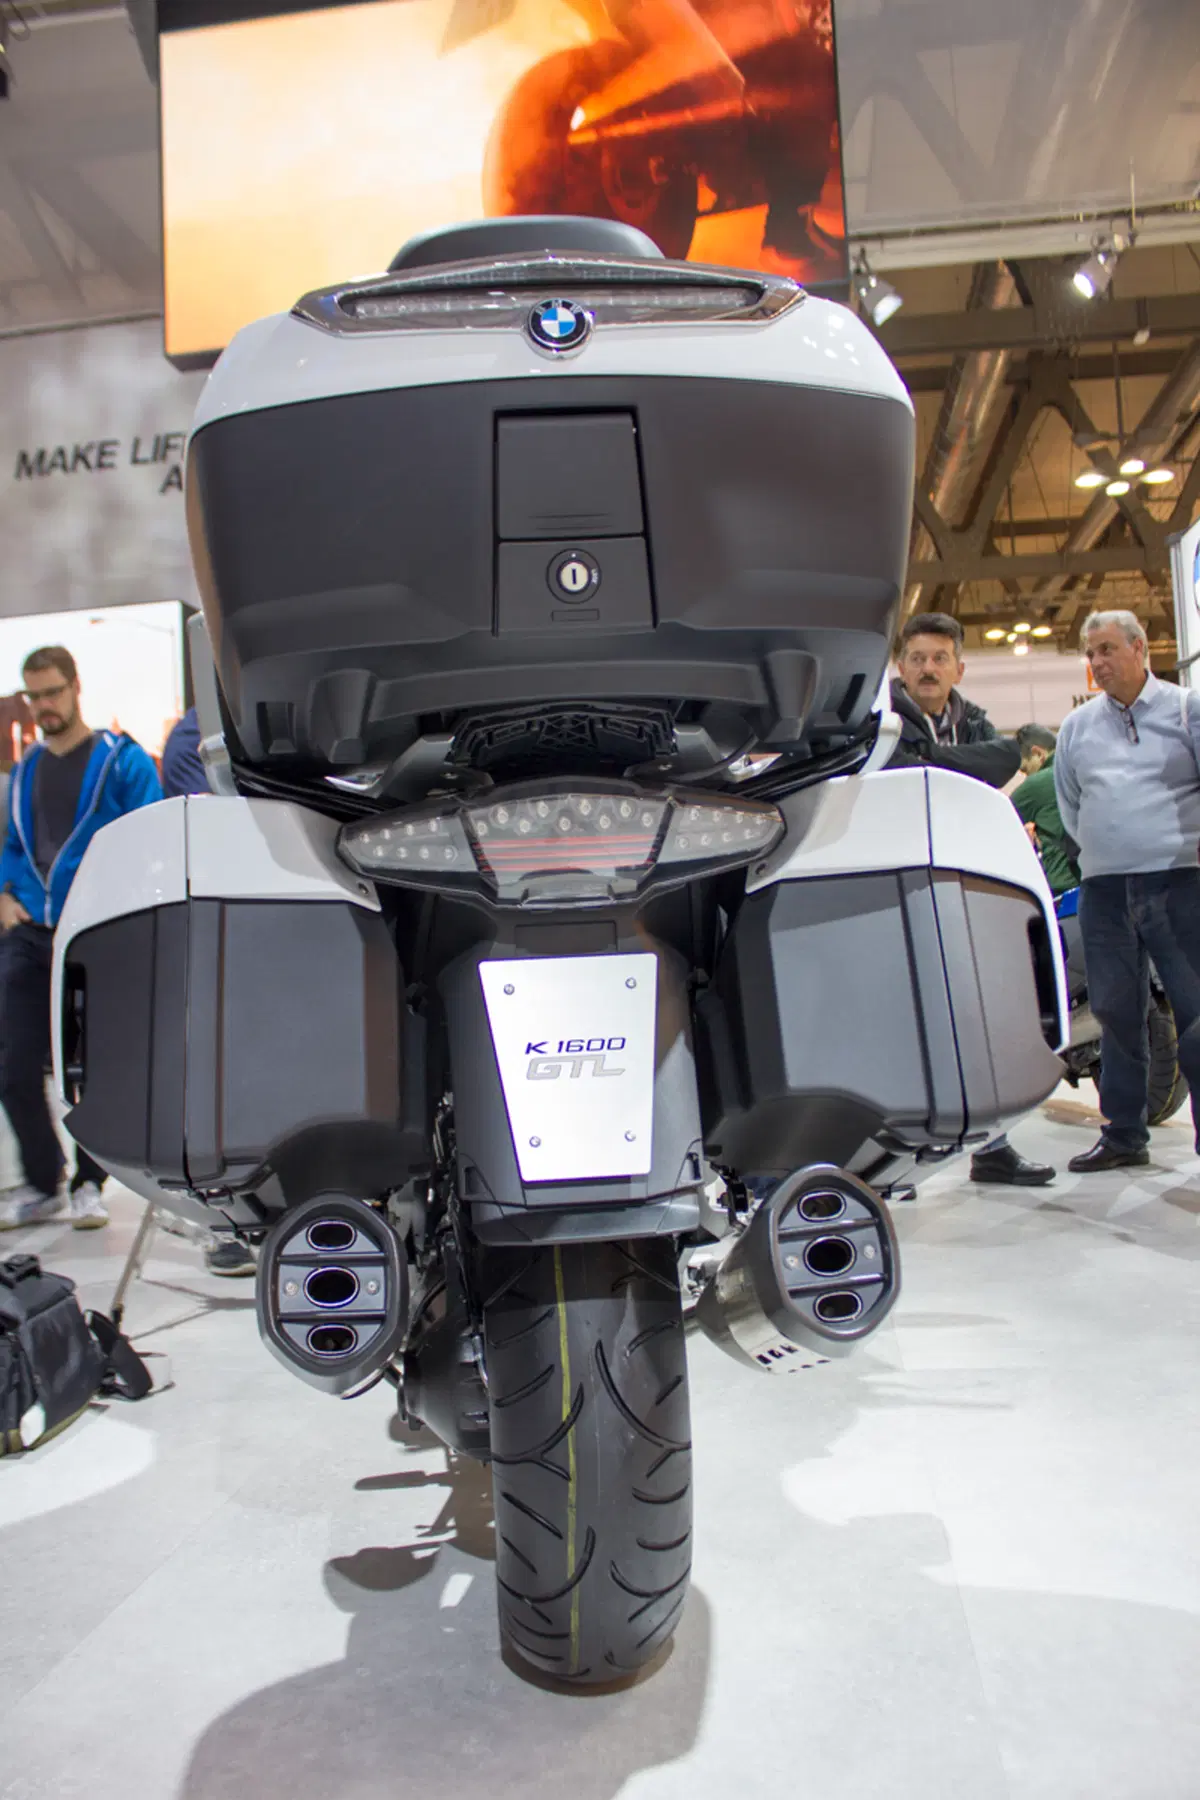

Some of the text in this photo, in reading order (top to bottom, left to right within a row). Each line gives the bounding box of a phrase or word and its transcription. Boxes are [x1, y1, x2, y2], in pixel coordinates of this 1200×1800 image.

[15, 432, 186, 480] MAKE LIF
[525, 1037, 627, 1055] K 1600
[526, 1054, 626, 1080] GTL
